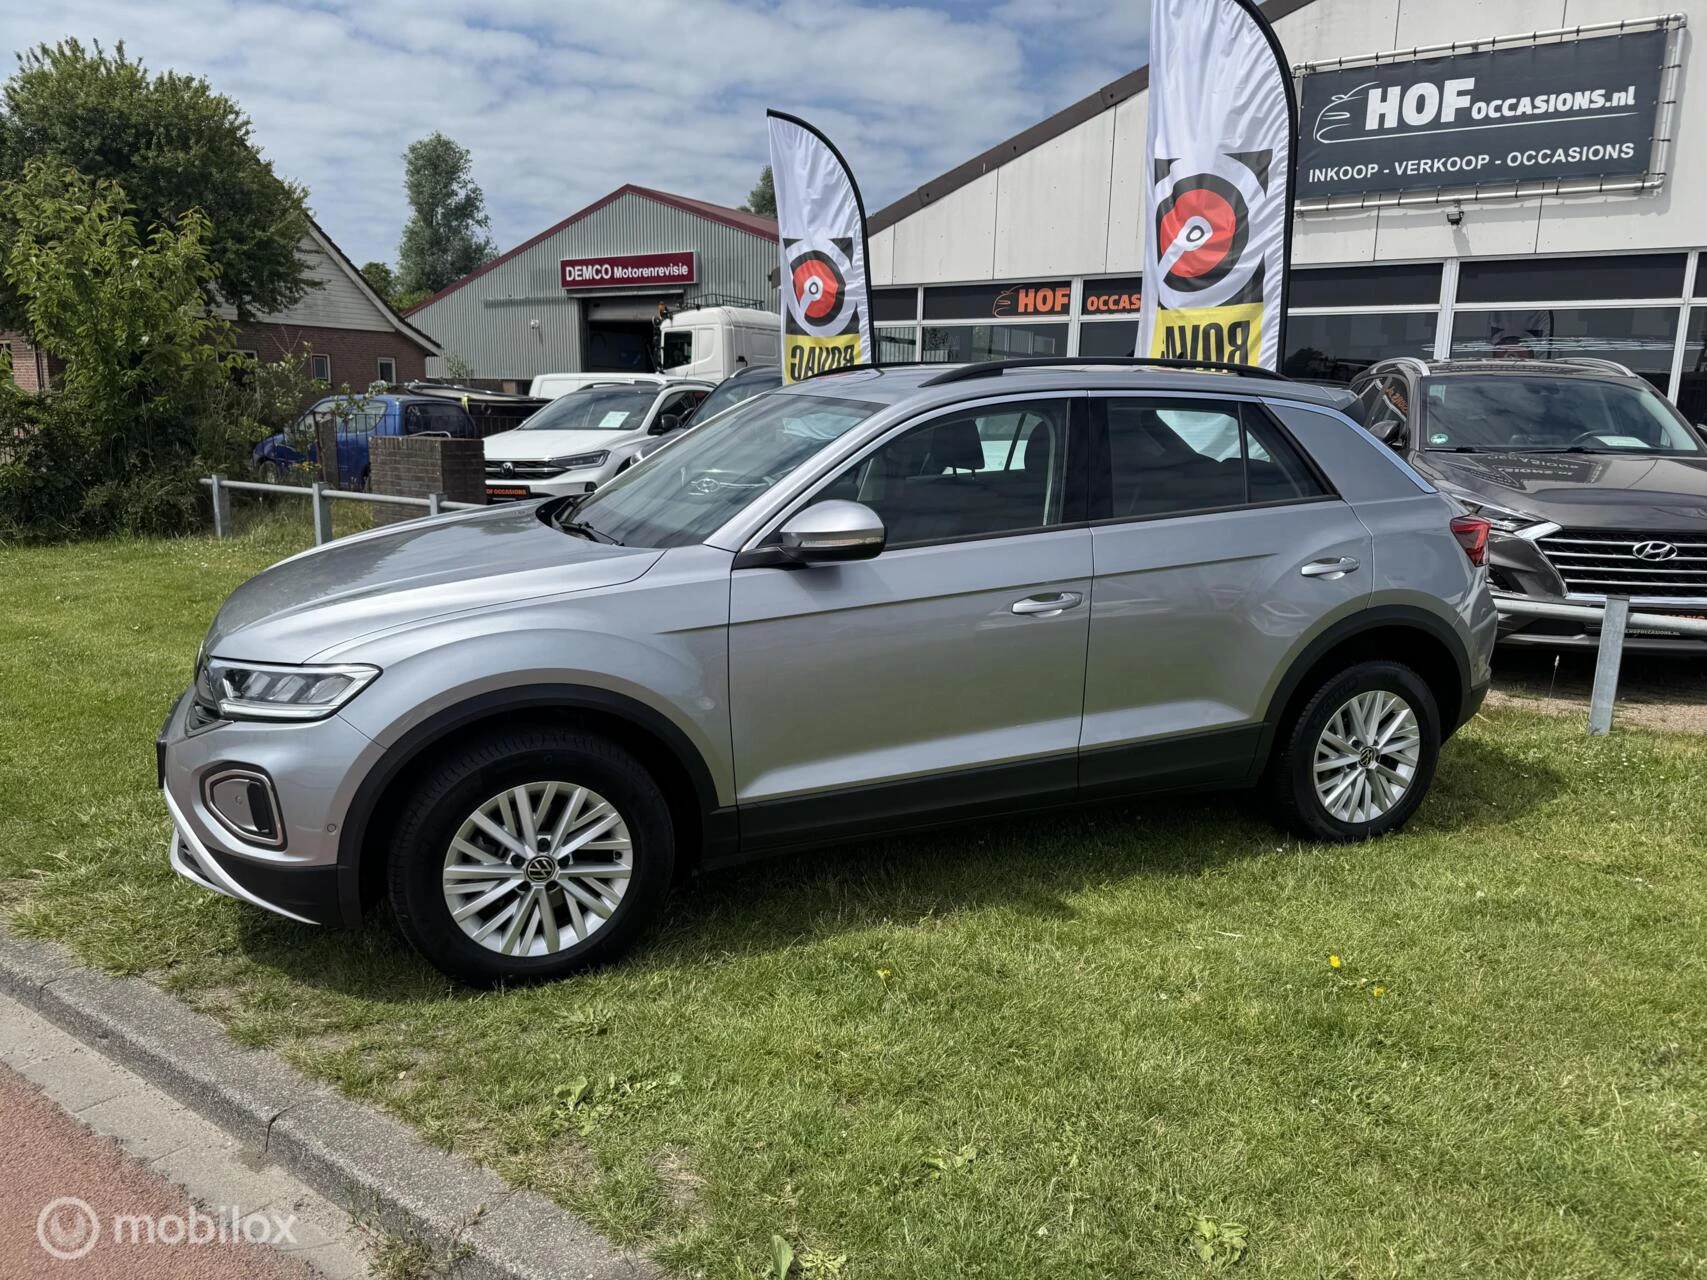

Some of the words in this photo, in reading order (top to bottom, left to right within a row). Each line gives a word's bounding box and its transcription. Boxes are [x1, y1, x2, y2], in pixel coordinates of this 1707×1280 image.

[1365, 77, 1475, 130] HOF
[1308, 163, 1379, 183] INKOOP
[1394, 154, 1490, 176] VERKOOP
[1506, 142, 1635, 167] OCCASIONS
[565, 264, 612, 281] DEMCO
[613, 263, 689, 279] Motorenrevisie
[1017, 287, 1070, 313] HOF
